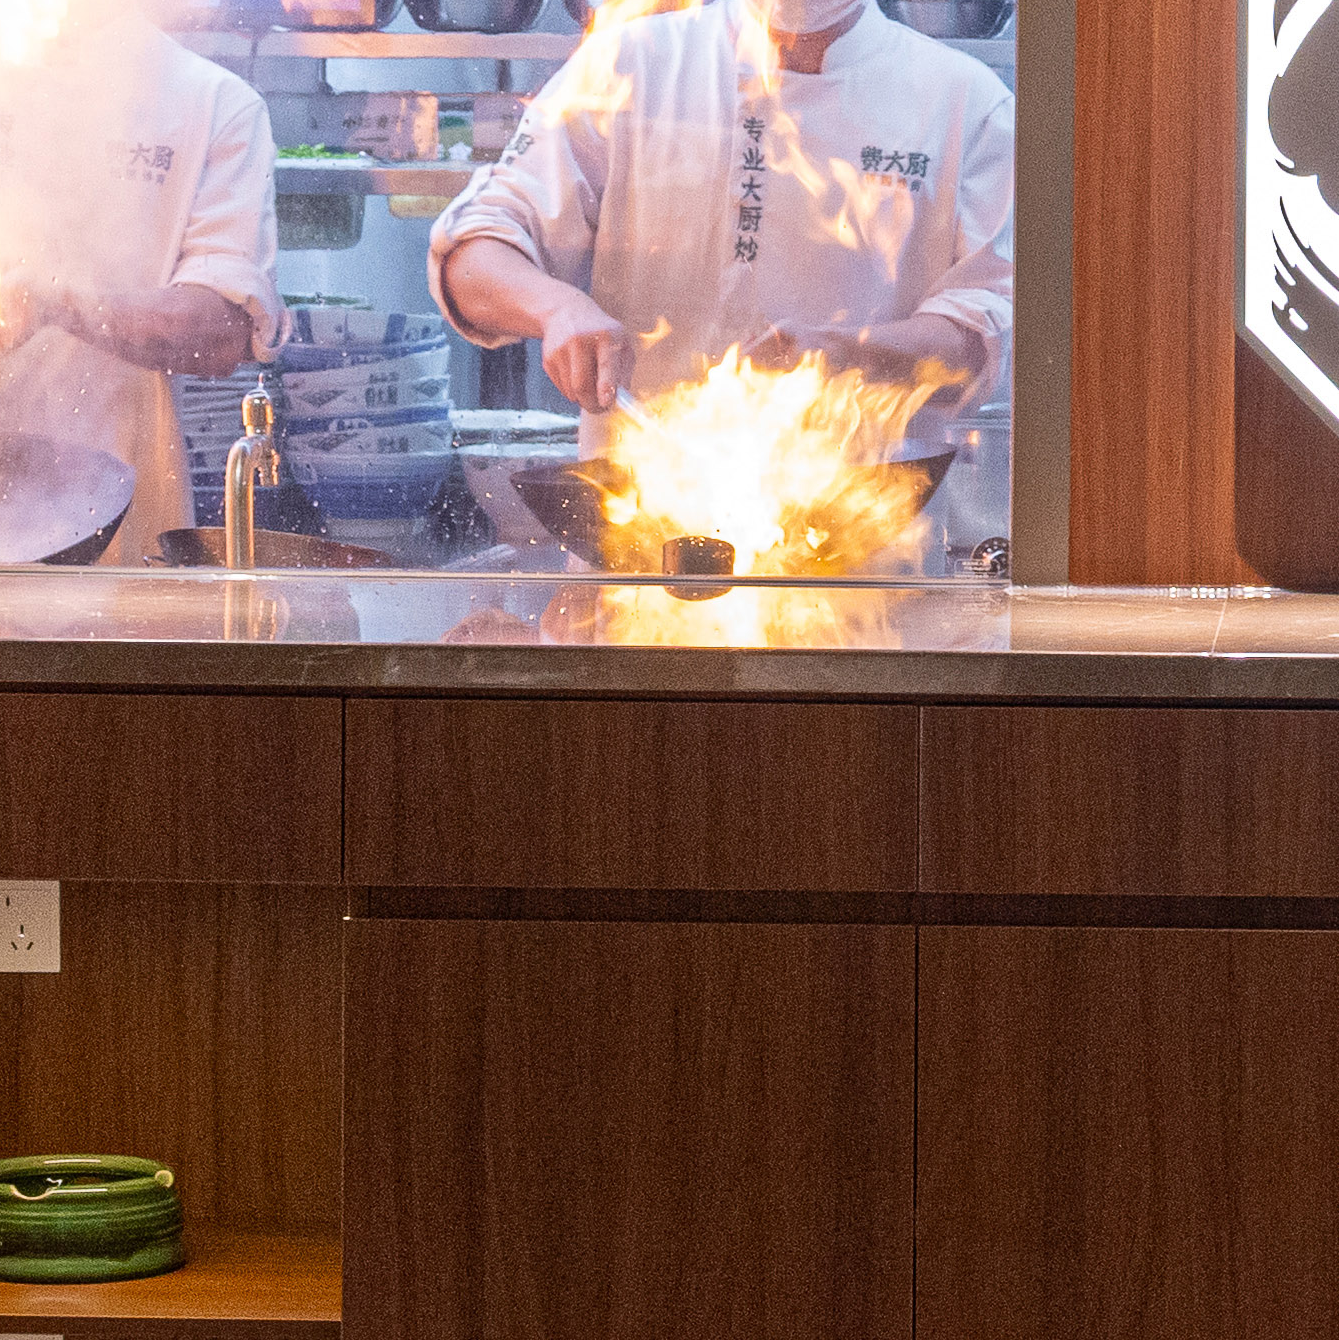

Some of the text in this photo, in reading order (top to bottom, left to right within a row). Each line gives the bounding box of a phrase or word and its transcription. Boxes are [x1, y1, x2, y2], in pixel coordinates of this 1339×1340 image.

[105, 141, 174, 171] 大厨
[861, 145, 930, 178] 费大厨
[734, 116, 765, 263] 专业大厨炒
